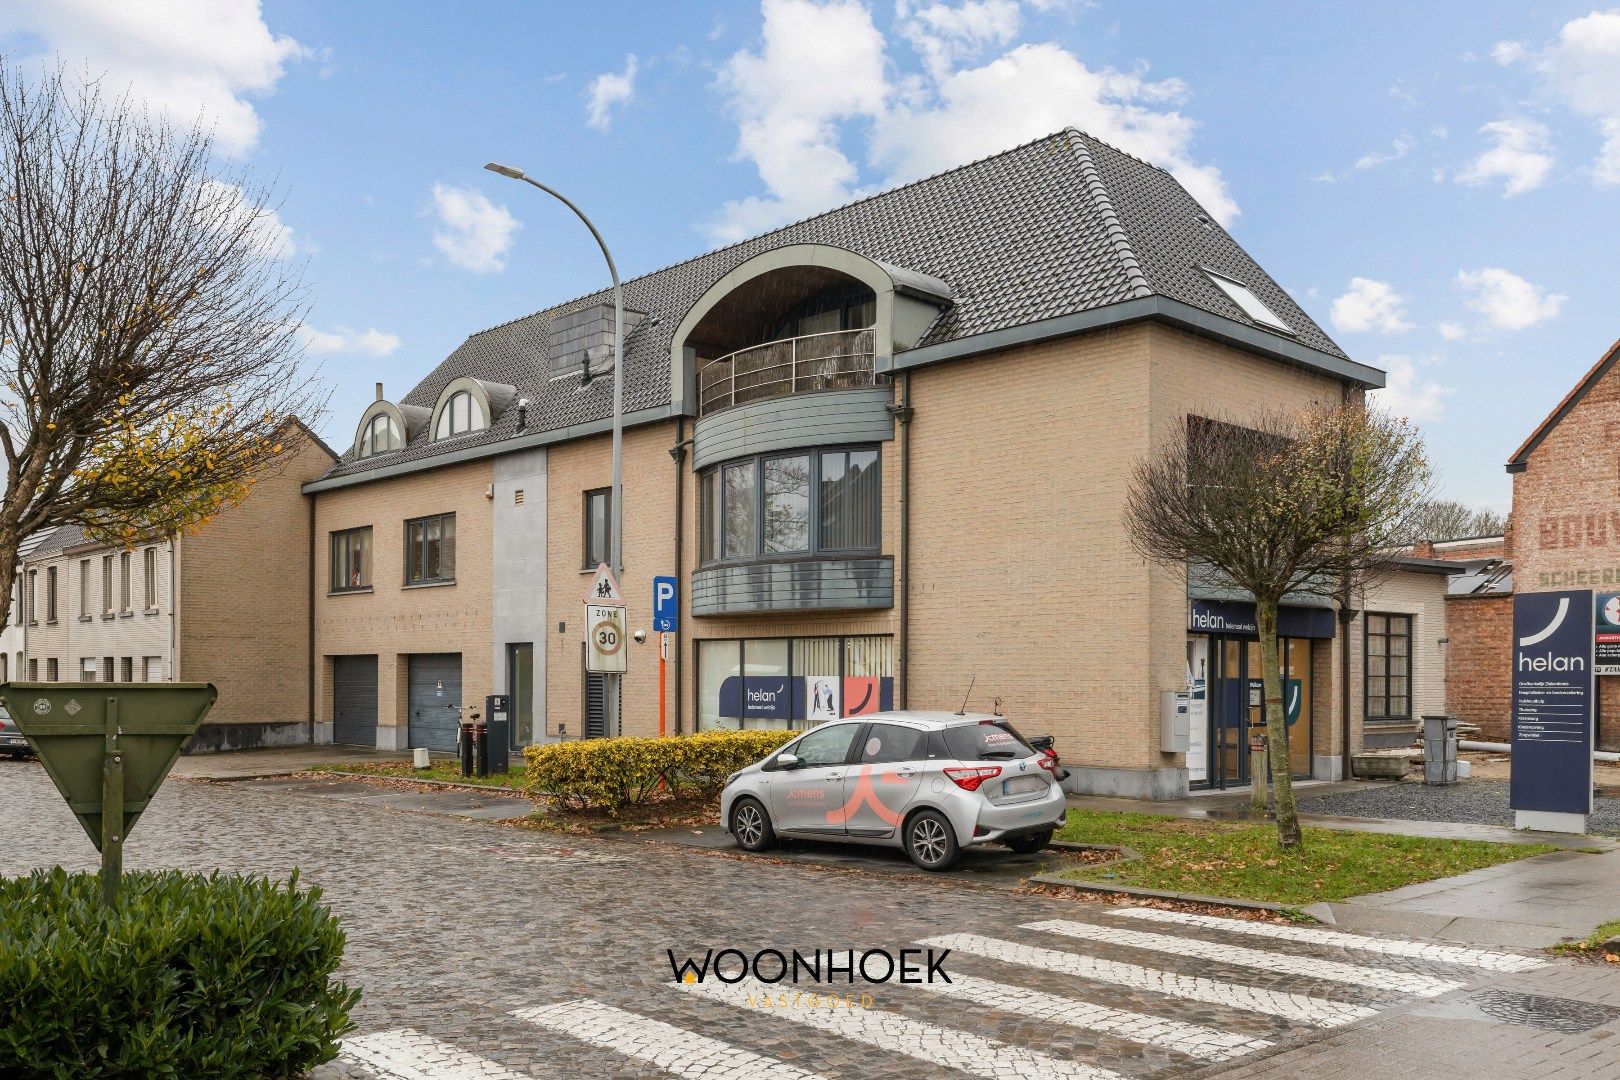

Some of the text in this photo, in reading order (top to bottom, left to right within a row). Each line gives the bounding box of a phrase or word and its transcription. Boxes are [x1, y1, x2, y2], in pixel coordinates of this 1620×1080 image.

[657, 582, 673, 611] P
[596, 609, 618, 618] ZONE
[1192, 608, 1224, 629] helan
[599, 631, 616, 645] 30
[1519, 651, 1584, 672] helan
[747, 688, 776, 702] helan
